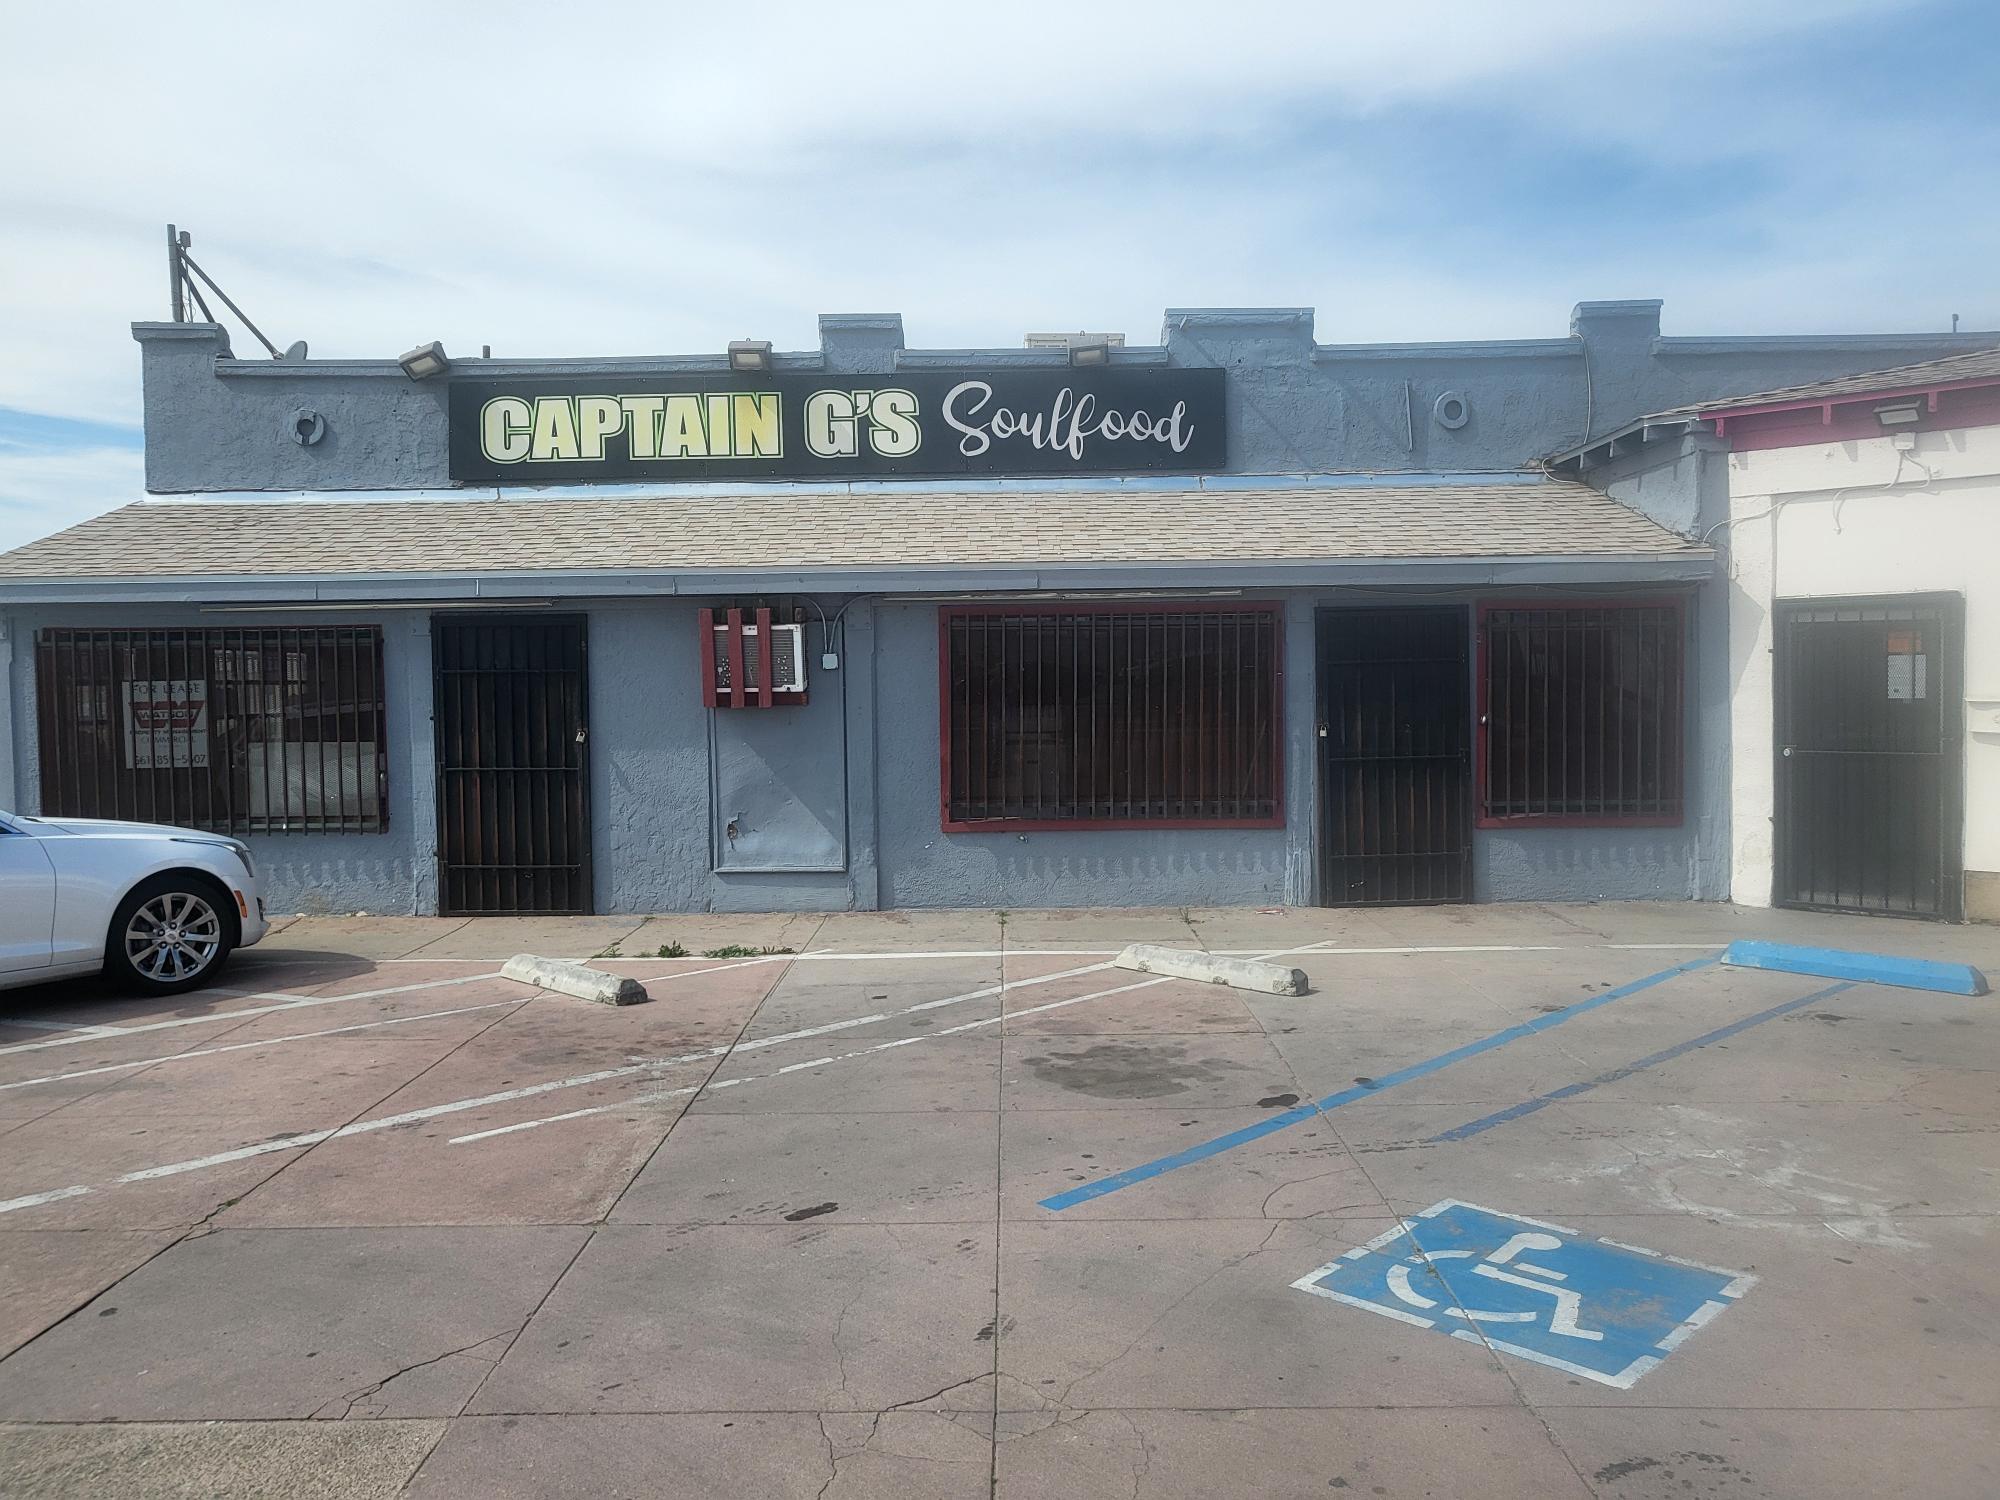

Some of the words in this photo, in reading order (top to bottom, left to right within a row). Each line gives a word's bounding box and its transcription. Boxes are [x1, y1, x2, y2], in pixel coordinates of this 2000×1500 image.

[480, 392, 784, 464] CAPTAIN
[803, 388, 922, 459] G'S
[942, 380, 1194, 460] Soulfood
[132, 684, 158, 694] FOR
[163, 683, 201, 694] LEASE
